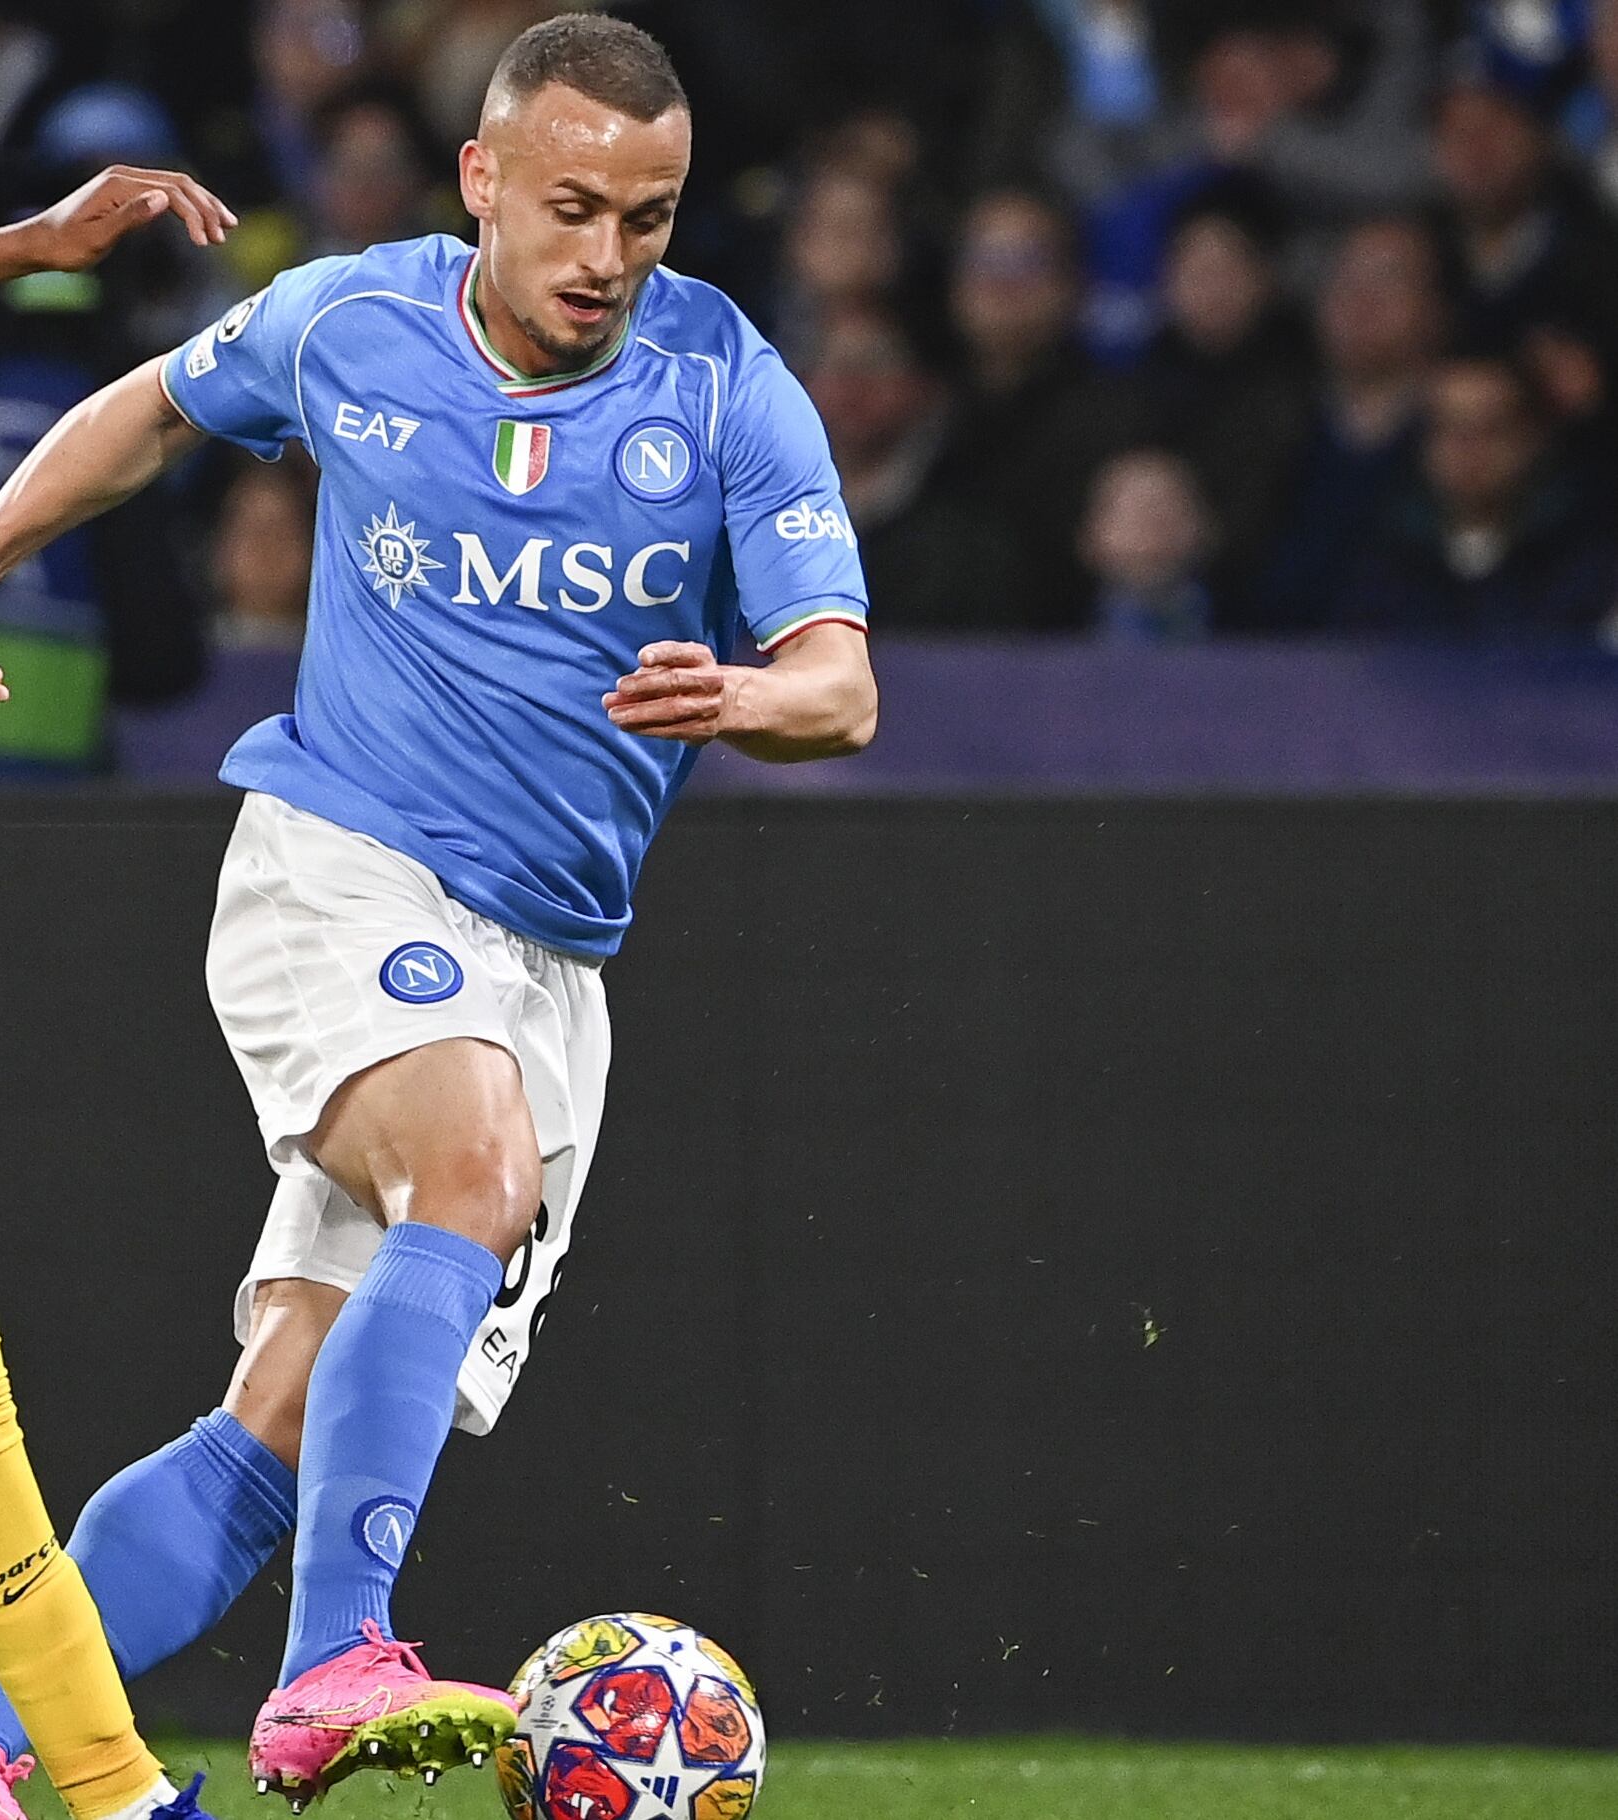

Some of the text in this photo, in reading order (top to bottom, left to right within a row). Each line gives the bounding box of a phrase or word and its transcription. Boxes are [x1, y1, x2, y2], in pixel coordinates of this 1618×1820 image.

[334, 402, 421, 451] EA7
[638, 440, 674, 479] N
[775, 501, 854, 549] ebay
[451, 531, 690, 613] MSC
[399, 955, 440, 987] N
[481, 1326, 517, 1384] EA
